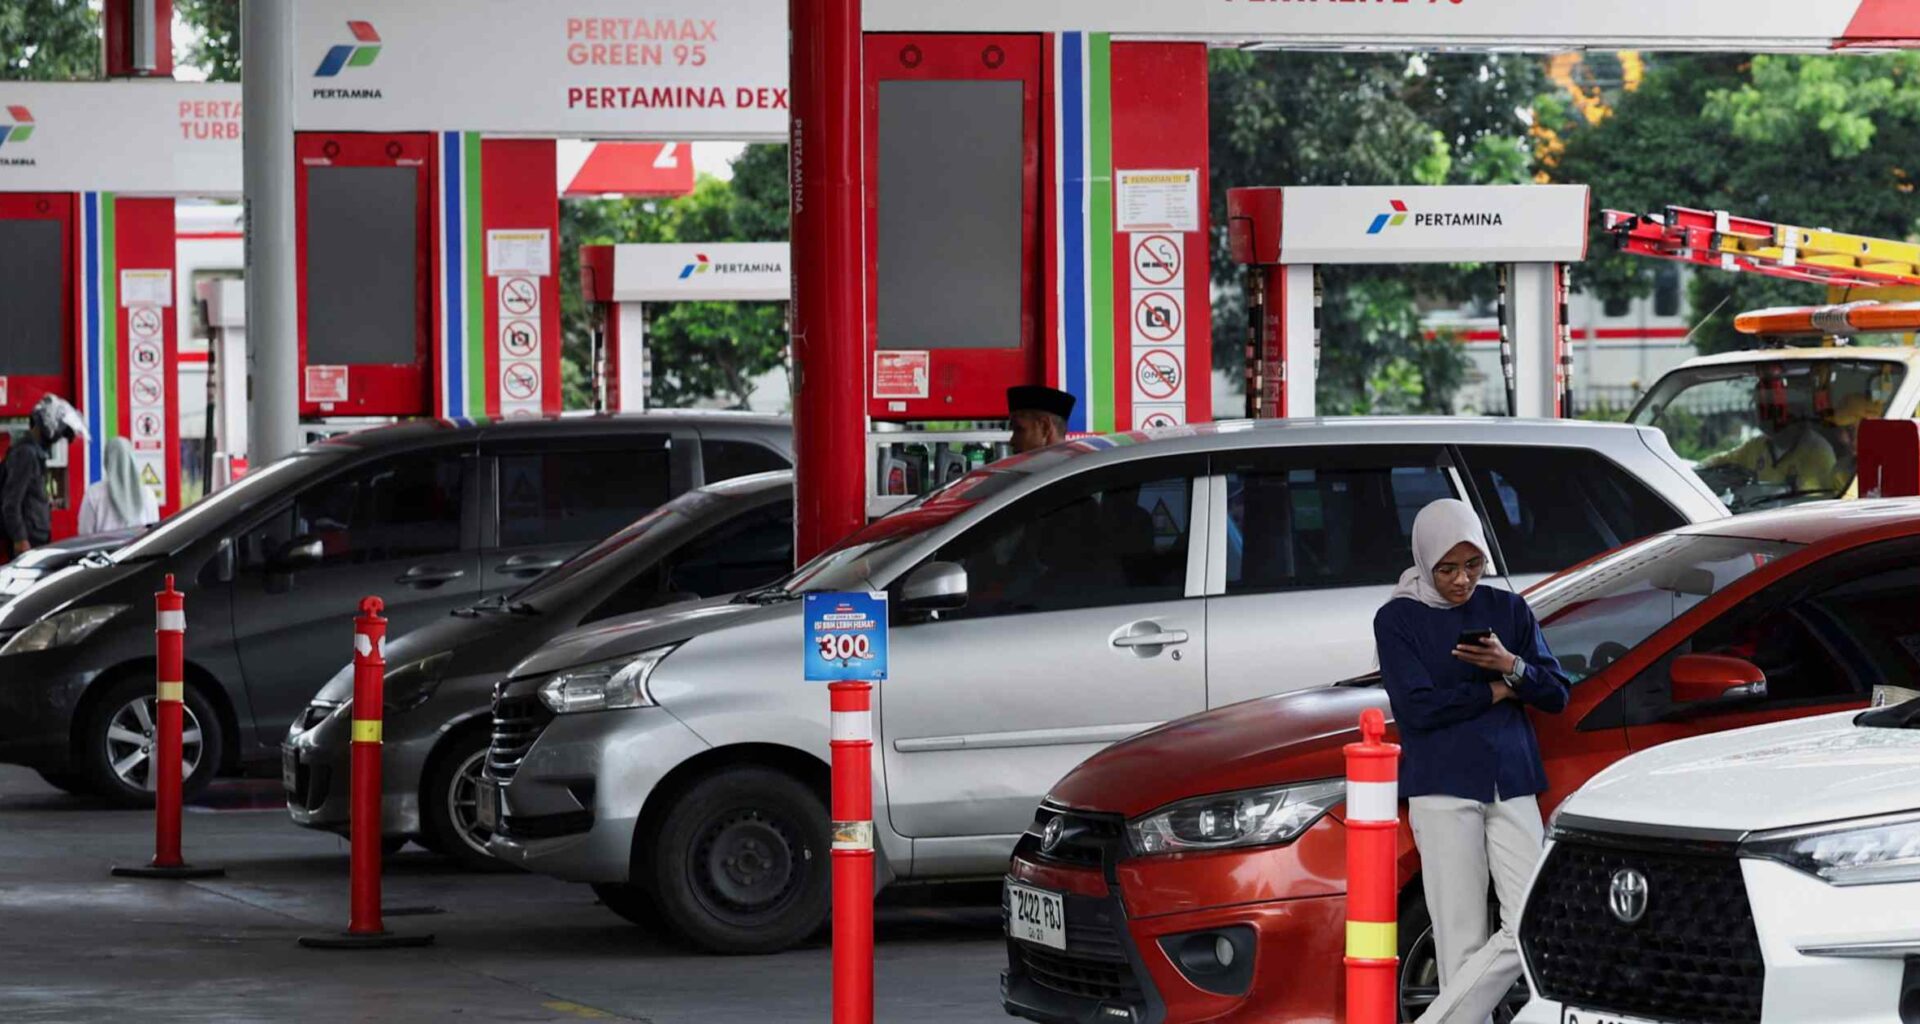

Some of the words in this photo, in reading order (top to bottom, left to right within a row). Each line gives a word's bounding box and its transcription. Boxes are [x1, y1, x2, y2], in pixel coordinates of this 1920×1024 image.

[567, 18, 717, 40] PERTAMAX
[567, 43, 662, 65] GREEN
[673, 44, 706, 66] 95
[312, 89, 382, 98] PERTAMINA
[568, 87, 726, 108] PERTAMINA
[736, 88, 788, 108] DEX
[1415, 213, 1503, 226] PERTAMINA
[715, 263, 782, 273] PERTAMINA
[821, 633, 869, 660] 300
[1018, 890, 1041, 924] 2422
[1042, 896, 1062, 930] FBJ
